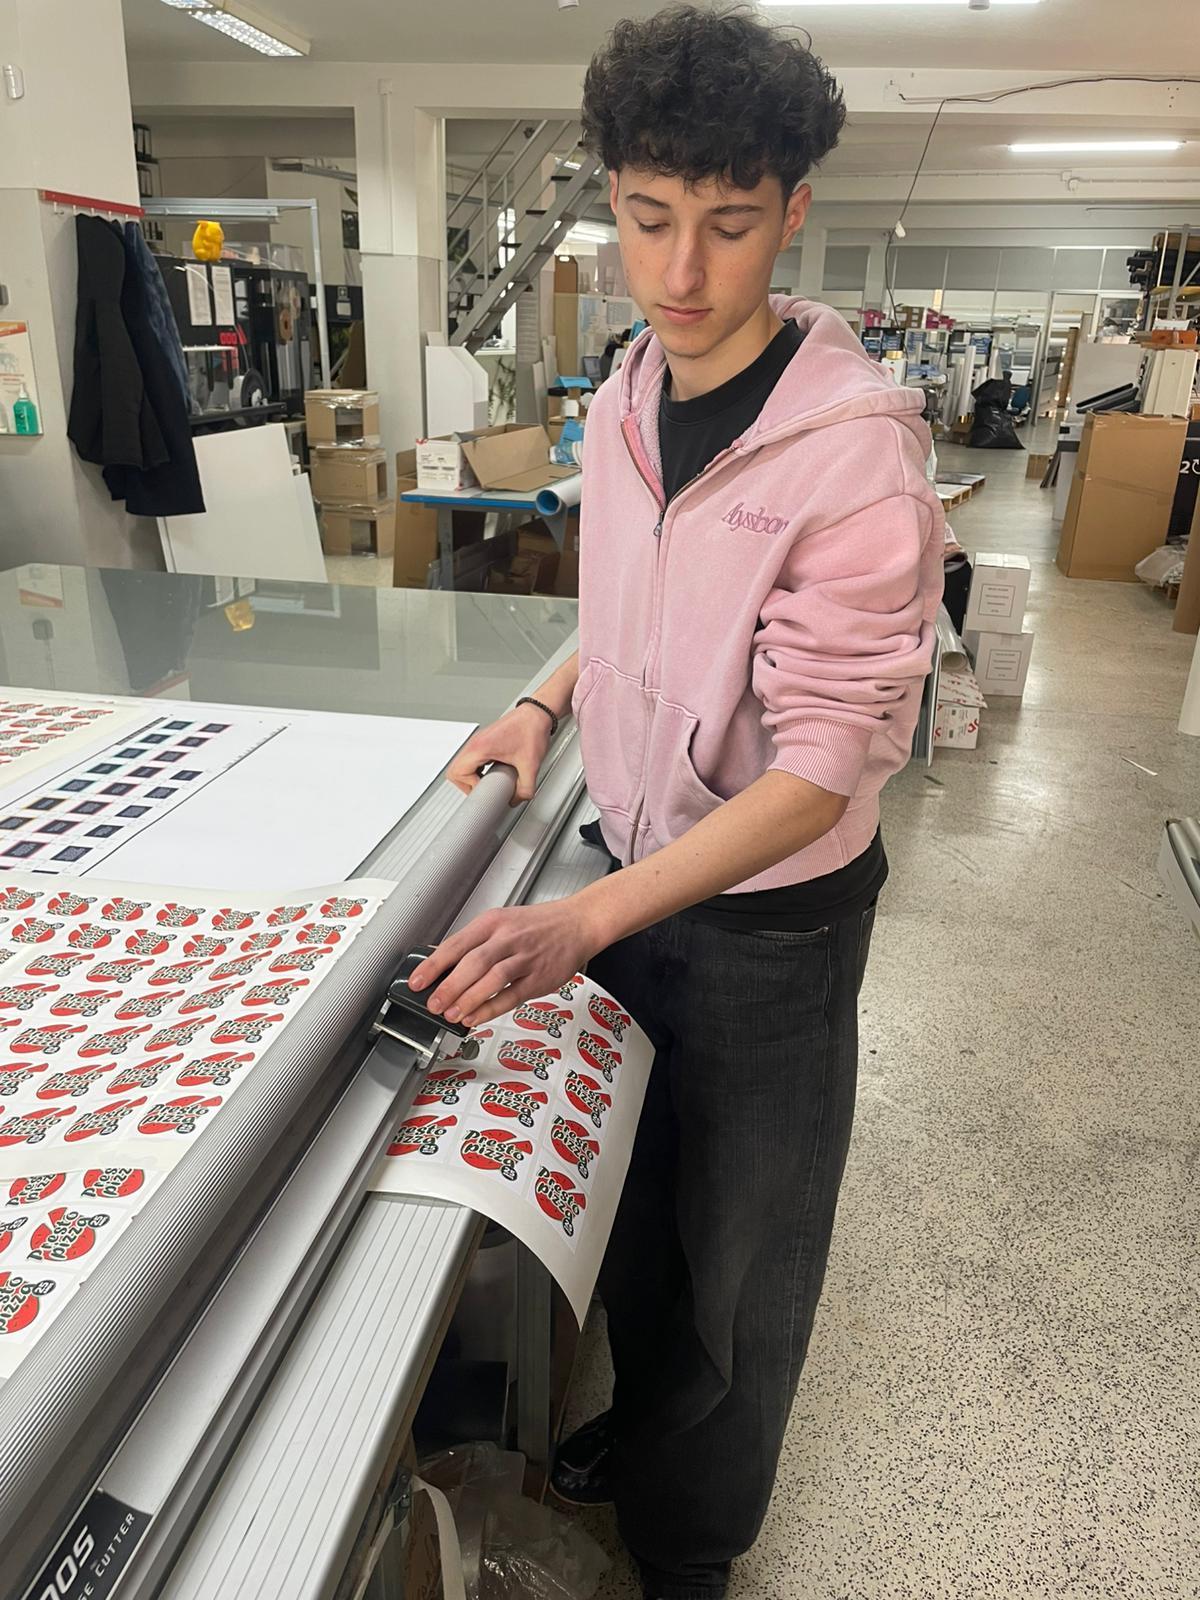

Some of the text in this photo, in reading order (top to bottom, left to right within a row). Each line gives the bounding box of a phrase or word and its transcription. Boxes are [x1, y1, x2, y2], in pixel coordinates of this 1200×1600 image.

[421, 1086, 457, 1096] izza
[424, 1078, 467, 1088] resto
[483, 1082, 540, 1110] Presto
[483, 1094, 532, 1117] pizza
[398, 1124, 447, 1137] resto
[553, 1115, 594, 1160] Presto
[464, 1130, 524, 1161] Presto
[464, 1143, 515, 1168] pizza
[81, 1168, 118, 1198] Pres
[103, 1168, 132, 1196] pizz
[538, 1166, 580, 1215] Presto
[27, 1211, 79, 1260] Presto
[95, 1513, 135, 1577] CUTTER
